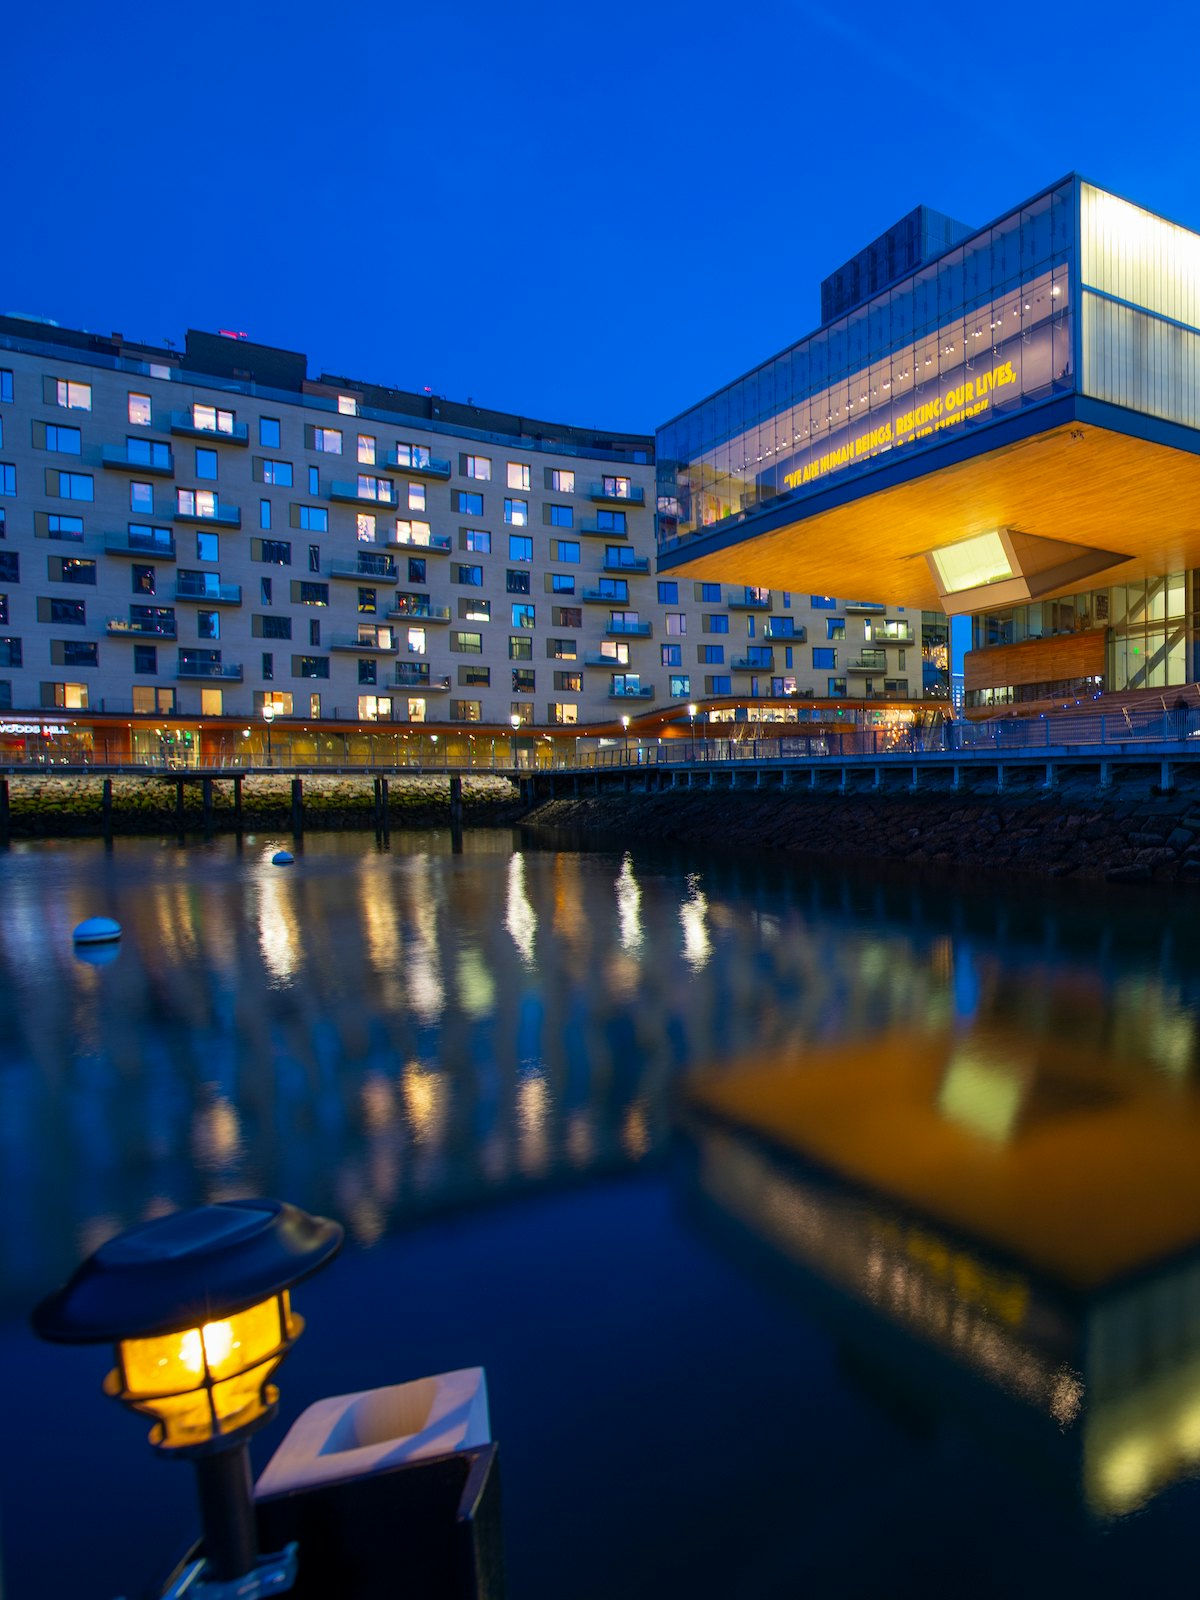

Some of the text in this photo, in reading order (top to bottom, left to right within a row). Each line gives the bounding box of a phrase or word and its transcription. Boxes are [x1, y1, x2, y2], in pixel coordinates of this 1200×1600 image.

[803, 459, 820, 483] ARE
[820, 441, 855, 475] HUMAN
[855, 422, 895, 456] BEINGS,
[896, 397, 944, 436] RISKING
[945, 382, 974, 412] OUR
[976, 360, 1017, 397] LIVES,
[43, 725, 69, 734] HILL
